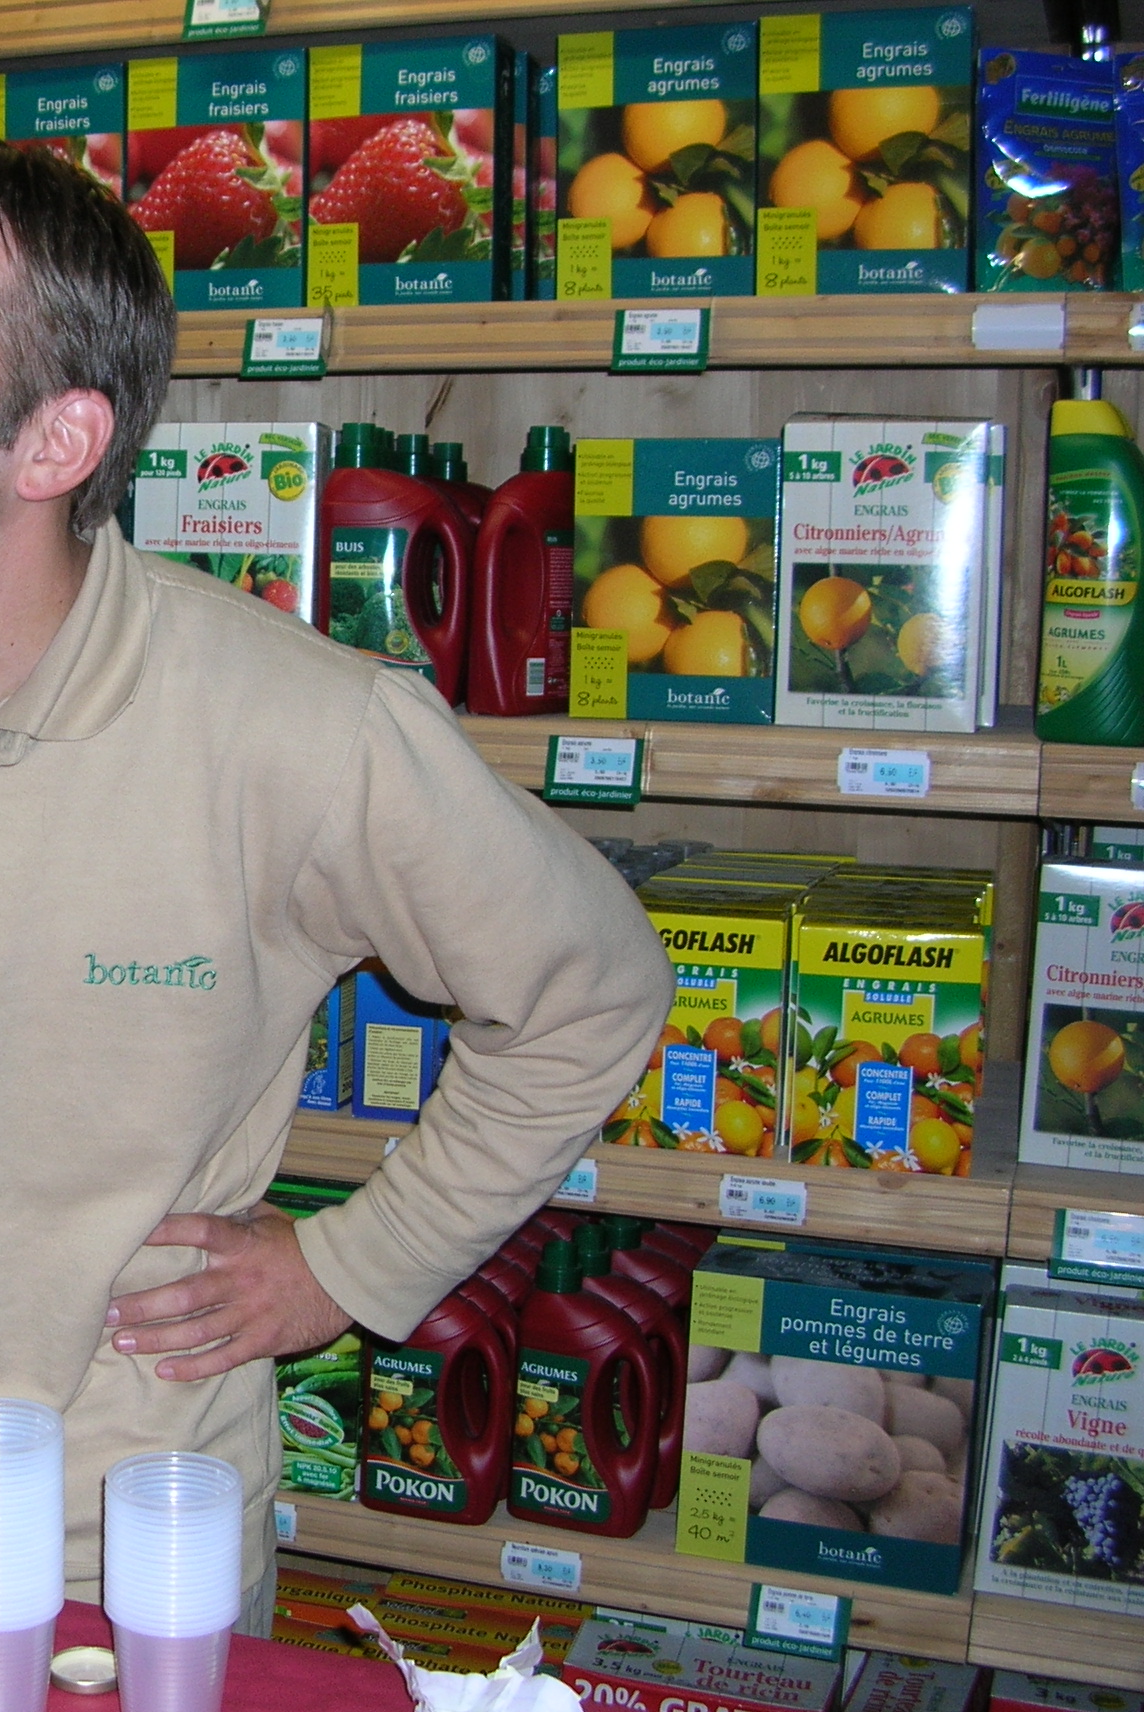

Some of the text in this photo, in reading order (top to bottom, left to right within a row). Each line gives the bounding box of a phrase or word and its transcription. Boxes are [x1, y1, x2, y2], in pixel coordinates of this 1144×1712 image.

[862, 41, 928, 62] Engrais
[653, 56, 715, 75] Engrais
[856, 62, 933, 81] agrumes
[398, 68, 456, 87] Engrais
[648, 77, 719, 95] agrumes
[212, 80, 267, 99] Engrais
[394, 89, 458, 106] fraisiers
[37, 95, 88, 113] Engrais
[209, 101, 269, 117] fraisiers
[1021, 88, 1110, 113] Fertiligène
[35, 115, 90, 132] fraisiers
[651, 268, 713, 287] botanic
[858, 261, 924, 281] botanic
[209, 280, 264, 297] botanic
[395, 274, 453, 291] botanic
[247, 362, 272, 374] produit
[619, 358, 647, 369] produit
[149, 452, 176, 469] 1 kg
[211, 441, 255, 463] JARDIN
[867, 443, 918, 465] JARDIN
[798, 454, 828, 472] 1 kg
[197, 470, 252, 494] Nature
[273, 472, 304, 492] Bio
[674, 470, 739, 491] Engrais
[853, 472, 915, 498] Nature
[197, 499, 247, 511] ENGRAIS
[668, 493, 743, 510] agrumes
[854, 504, 909, 517] ENGRAIS
[181, 514, 263, 536] Fraisiers
[335, 541, 365, 553] BUIS
[1051, 584, 1126, 600] ALGOFLASH
[1048, 626, 1106, 641] AGRUMES
[577, 691, 619, 707] 8 plants
[667, 687, 731, 706] botanic
[550, 788, 579, 798] produit
[1055, 895, 1086, 916] 1 kg
[659, 927, 756, 955] GOFLASH
[822, 941, 954, 969] ALGOFLASH
[83, 952, 218, 991] botanic
[676, 964, 739, 978] GRAIS
[842, 977, 937, 994] ENGRAIS
[865, 991, 913, 1004] SOLUBLE
[851, 1010, 925, 1026] AGRUMES
[667, 1050, 712, 1063] CONCENTRE
[671, 1072, 707, 1084] COMPLET
[861, 1067, 909, 1080] CONCENTRE
[674, 1097, 702, 1108] RAPIDE
[865, 1090, 902, 1102] COMPLET
[867, 1115, 897, 1127] RAPIDE
[1057, 1265, 1089, 1277] produit
[830, 1298, 906, 1324] Engrais
[780, 1315, 954, 1350] pommes de terre
[809, 1338, 922, 1367] et légumes
[1018, 1337, 1048, 1358] 1 kg
[373, 1355, 433, 1375] AGRUMES
[520, 1361, 579, 1382] AGRUMES
[1071, 1393, 1128, 1412] ENGRAIS
[1067, 1408, 1127, 1438] Vigne
[1015, 1428, 1051, 1442] récolte
[1109, 1442, 1120, 1452] et
[1122, 1444, 1135, 1455] de
[690, 1455, 743, 1471] Minigranulés
[689, 1465, 740, 1481] Boîte semoir
[375, 1468, 454, 1502] POKON
[520, 1476, 598, 1513] POKON
[688, 1524, 712, 1541] 40
[818, 1541, 883, 1565] botanic
[399, 1578, 584, 1612] Phosphate Naturel
[381, 1611, 488, 1638] Phosphate
[751, 1636, 781, 1649] produit
[693, 1657, 813, 1691] Tourteau
[574, 1678, 647, 1712] 20%
[695, 1676, 800, 1702] de ricin
